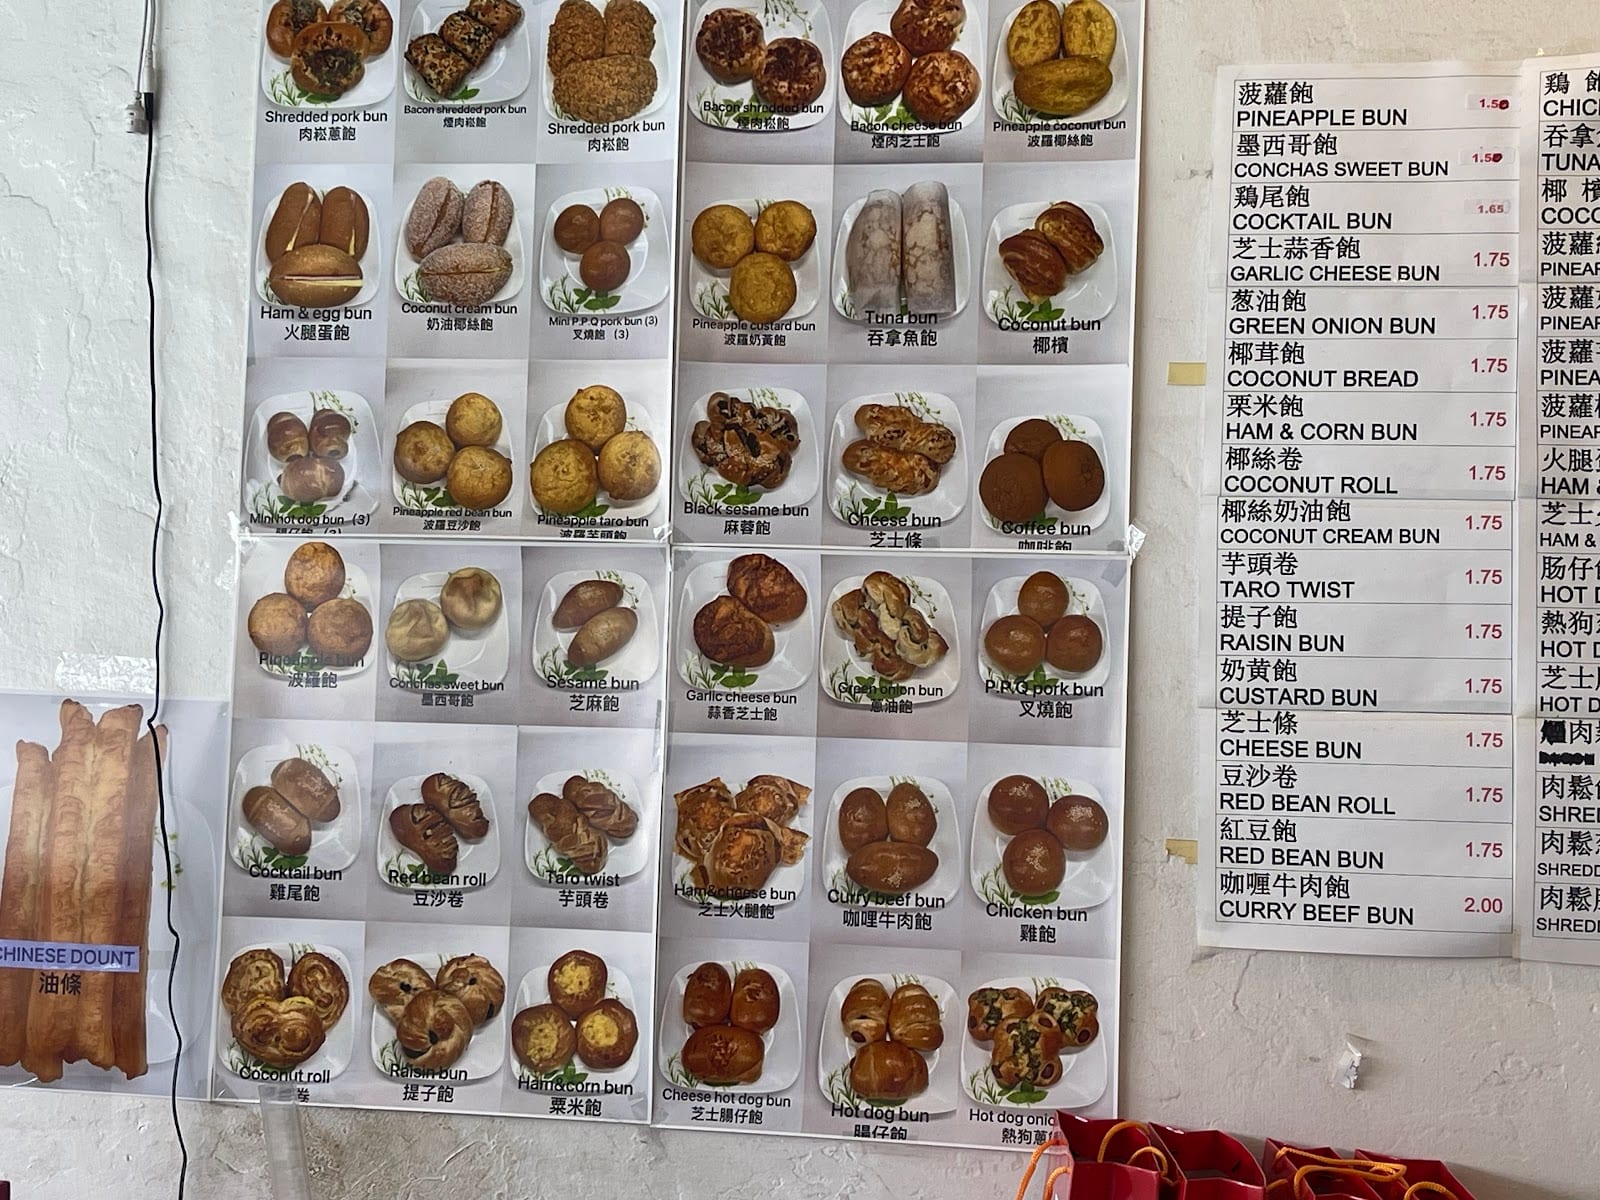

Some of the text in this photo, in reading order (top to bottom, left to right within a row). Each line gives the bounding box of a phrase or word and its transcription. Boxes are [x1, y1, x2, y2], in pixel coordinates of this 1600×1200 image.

[1238, 81, 1313, 106] 菠蘿飽
[265, 110, 387, 124] Shredded pork bun
[404, 105, 527, 115] Bacon shredded pork bun
[1236, 109, 1407, 127] PINEAPPLE BUN
[993, 119, 1126, 133] Pineapple coconut bun
[1237, 133, 1338, 157] 墨西哥飽
[1234, 161, 1449, 178] CONCHAS SWEET BUN
[1541, 154, 1600, 171] TUNA
[1477, 204, 1504, 214] 1.65
[1233, 213, 1392, 230] COCKTAIL BUN
[1232, 236, 1360, 260] 芝士蒜香飽
[1473, 252, 1510, 267] 1.75
[1231, 266, 1440, 281] GARLIC CHEESE BUN
[260, 306, 372, 322] Ham & egg bun
[401, 303, 518, 314] Coconut cream bun
[865, 310, 937, 324] Tuna bun
[1472, 305, 1509, 320] 1.75
[549, 317, 570, 326] Mini
[600, 317, 622, 328] pork
[624, 316, 642, 326] bun
[645, 316, 658, 327] (3)
[692, 318, 815, 331] Pineapple custard bun
[1229, 318, 1436, 335] GREEN ONION BUN
[284, 324, 350, 341] 火腿蛋飽
[867, 329, 937, 347] 吞拿魚飽
[1228, 341, 1305, 366] 椰茸飽
[1471, 358, 1508, 373] 1.75
[1227, 371, 1418, 387] COCONUT BREAD
[1470, 412, 1507, 427] 1.75
[1226, 423, 1417, 440] HAM & CORN BUN
[1225, 447, 1302, 471] 椰絲卷
[1469, 465, 1505, 480] 1.75
[1224, 476, 1398, 494] COCONUT ROLL
[1542, 476, 1589, 495] HAM
[684, 502, 808, 516] Black sesame bun
[1221, 499, 1350, 523] 椰絲奶油飽
[849, 513, 941, 527] Cheese bun
[1466, 516, 1502, 530] 1.75
[1220, 528, 1440, 544] COCONUT CREAM BUN
[1540, 533, 1596, 547] HAM &
[1222, 551, 1298, 576] 芋頭卷
[1465, 570, 1502, 584] 1.75
[1220, 581, 1355, 598] TARO TWIST
[1541, 586, 1588, 603] HOT
[1220, 604, 1297, 629] 提子飽
[1465, 624, 1502, 639] 1.75
[1220, 634, 1344, 652] RAISIN BUN
[1541, 640, 1586, 658] HOT
[547, 675, 639, 690] Sesame bun
[1032, 680, 1071, 698] pork
[1073, 682, 1104, 697] bun
[1465, 679, 1502, 694] 1.75
[569, 695, 619, 712] 芝麻飽
[686, 689, 797, 704] Garlic cheese bun
[1220, 687, 1377, 706] CUSTARD BUN
[1540, 696, 1582, 712] HOT
[708, 706, 777, 721] 蒜香芝士飽
[1019, 700, 1072, 719] 叉燒飽
[1220, 710, 1298, 735] 芝士條
[1466, 732, 1503, 747] 1.75
[1220, 739, 1361, 759] CHEESE BUN
[1220, 764, 1298, 789] 豆沙卷
[1466, 787, 1503, 802] 1.75
[1220, 793, 1396, 815] RED BEAN ROLL
[1220, 817, 1297, 843] 紅豆飽
[1220, 847, 1384, 869] RED BEAN BUN
[1466, 843, 1503, 858] 1.75
[250, 865, 342, 880] Cocktail bun
[388, 869, 486, 886] Red bean roll
[546, 870, 620, 886] Taro twist
[413, 890, 464, 908] 豆沙卷
[559, 891, 609, 909] 芋頭卷
[1464, 898, 1503, 913] 2.00
[986, 902, 1087, 922] Chicken bun
[1219, 900, 1414, 925] CURRY BEEF BUN
[70, 949, 135, 966] DOUNT
[38, 972, 82, 996] 油條
[390, 1064, 467, 1081] Raisin bun
[403, 1085, 454, 1103] 提子飽
[518, 1076, 633, 1095] Ham&corn bun
[662, 1088, 791, 1108] Cheese hot dog bun
